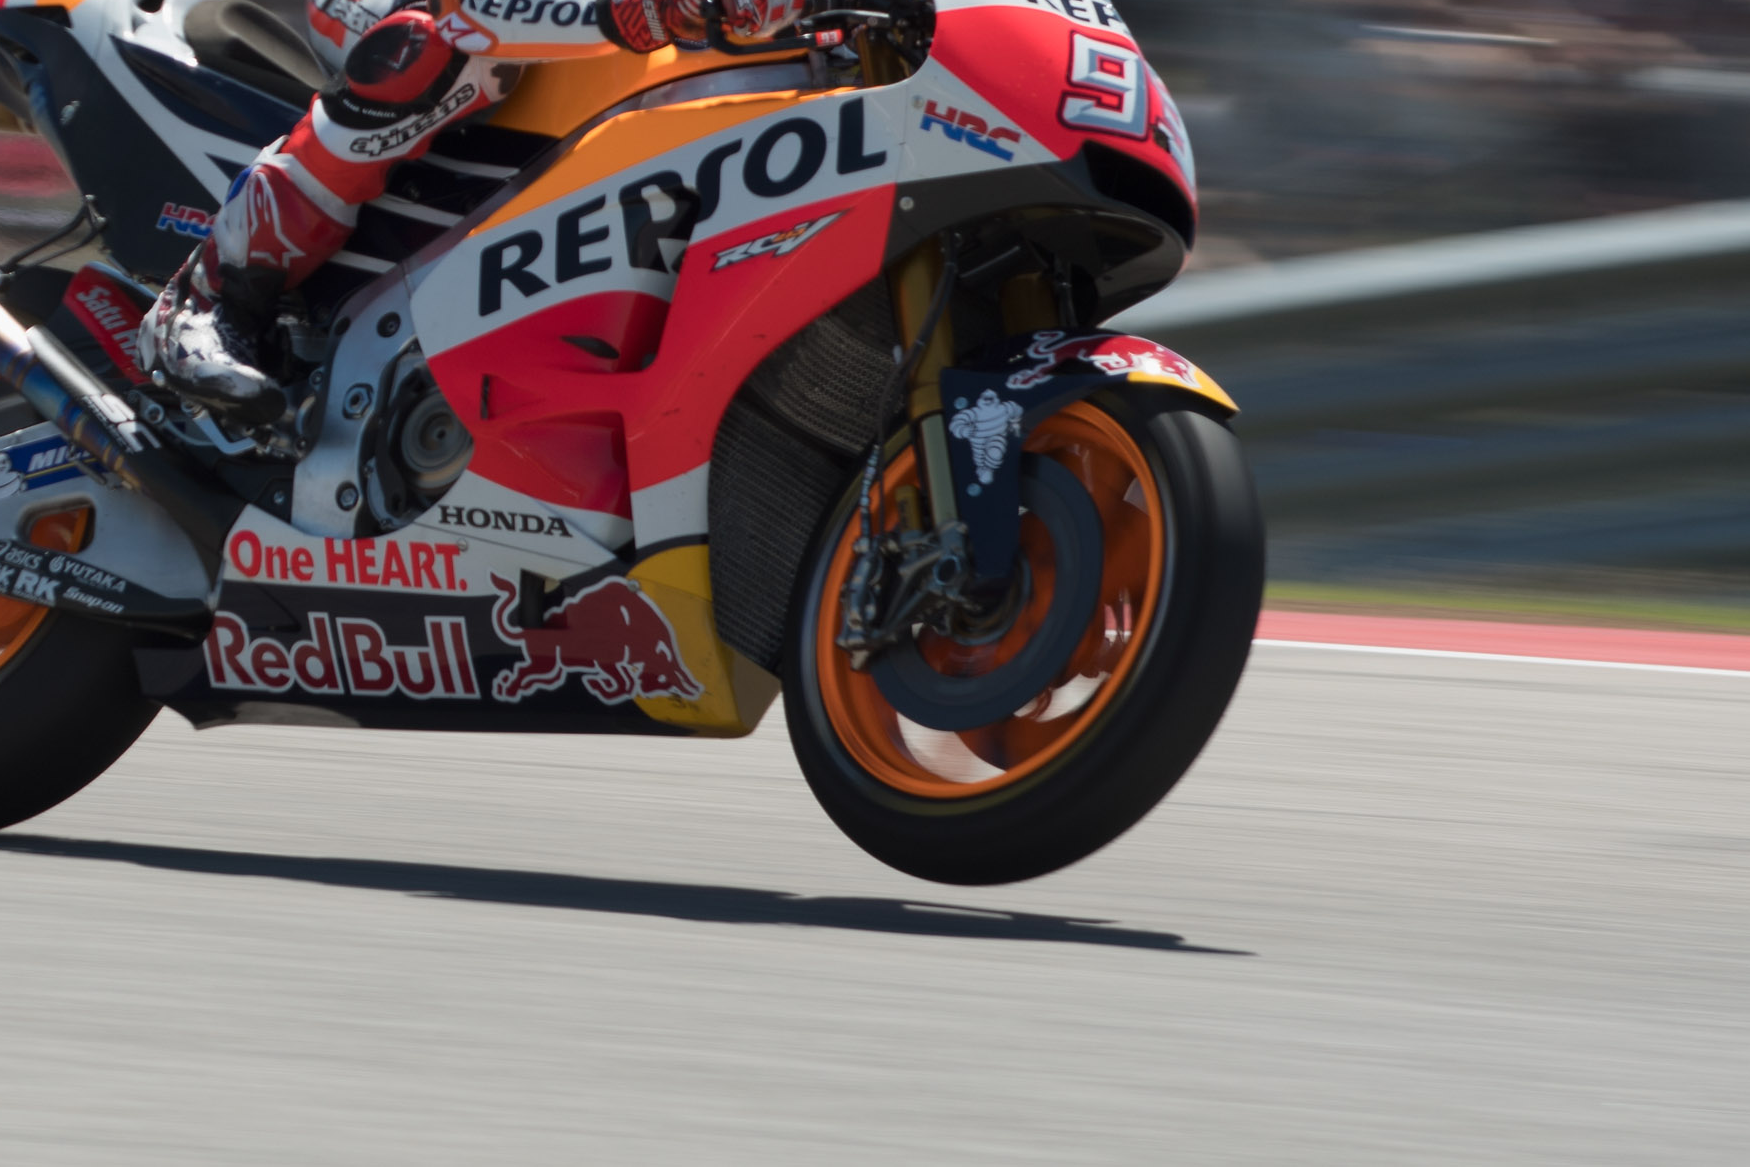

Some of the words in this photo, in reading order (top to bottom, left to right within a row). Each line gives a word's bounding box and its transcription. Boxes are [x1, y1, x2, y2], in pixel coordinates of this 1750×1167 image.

[920, 99, 1021, 162] HRC
[479, 97, 888, 318] REPSOL
[76, 285, 128, 331] Satu
[438, 504, 573, 538] HONDA
[64, 559, 127, 593] YUTAKA
[228, 529, 315, 581] One
[324, 537, 468, 592] HEART.
[16, 569, 61, 602] RK
